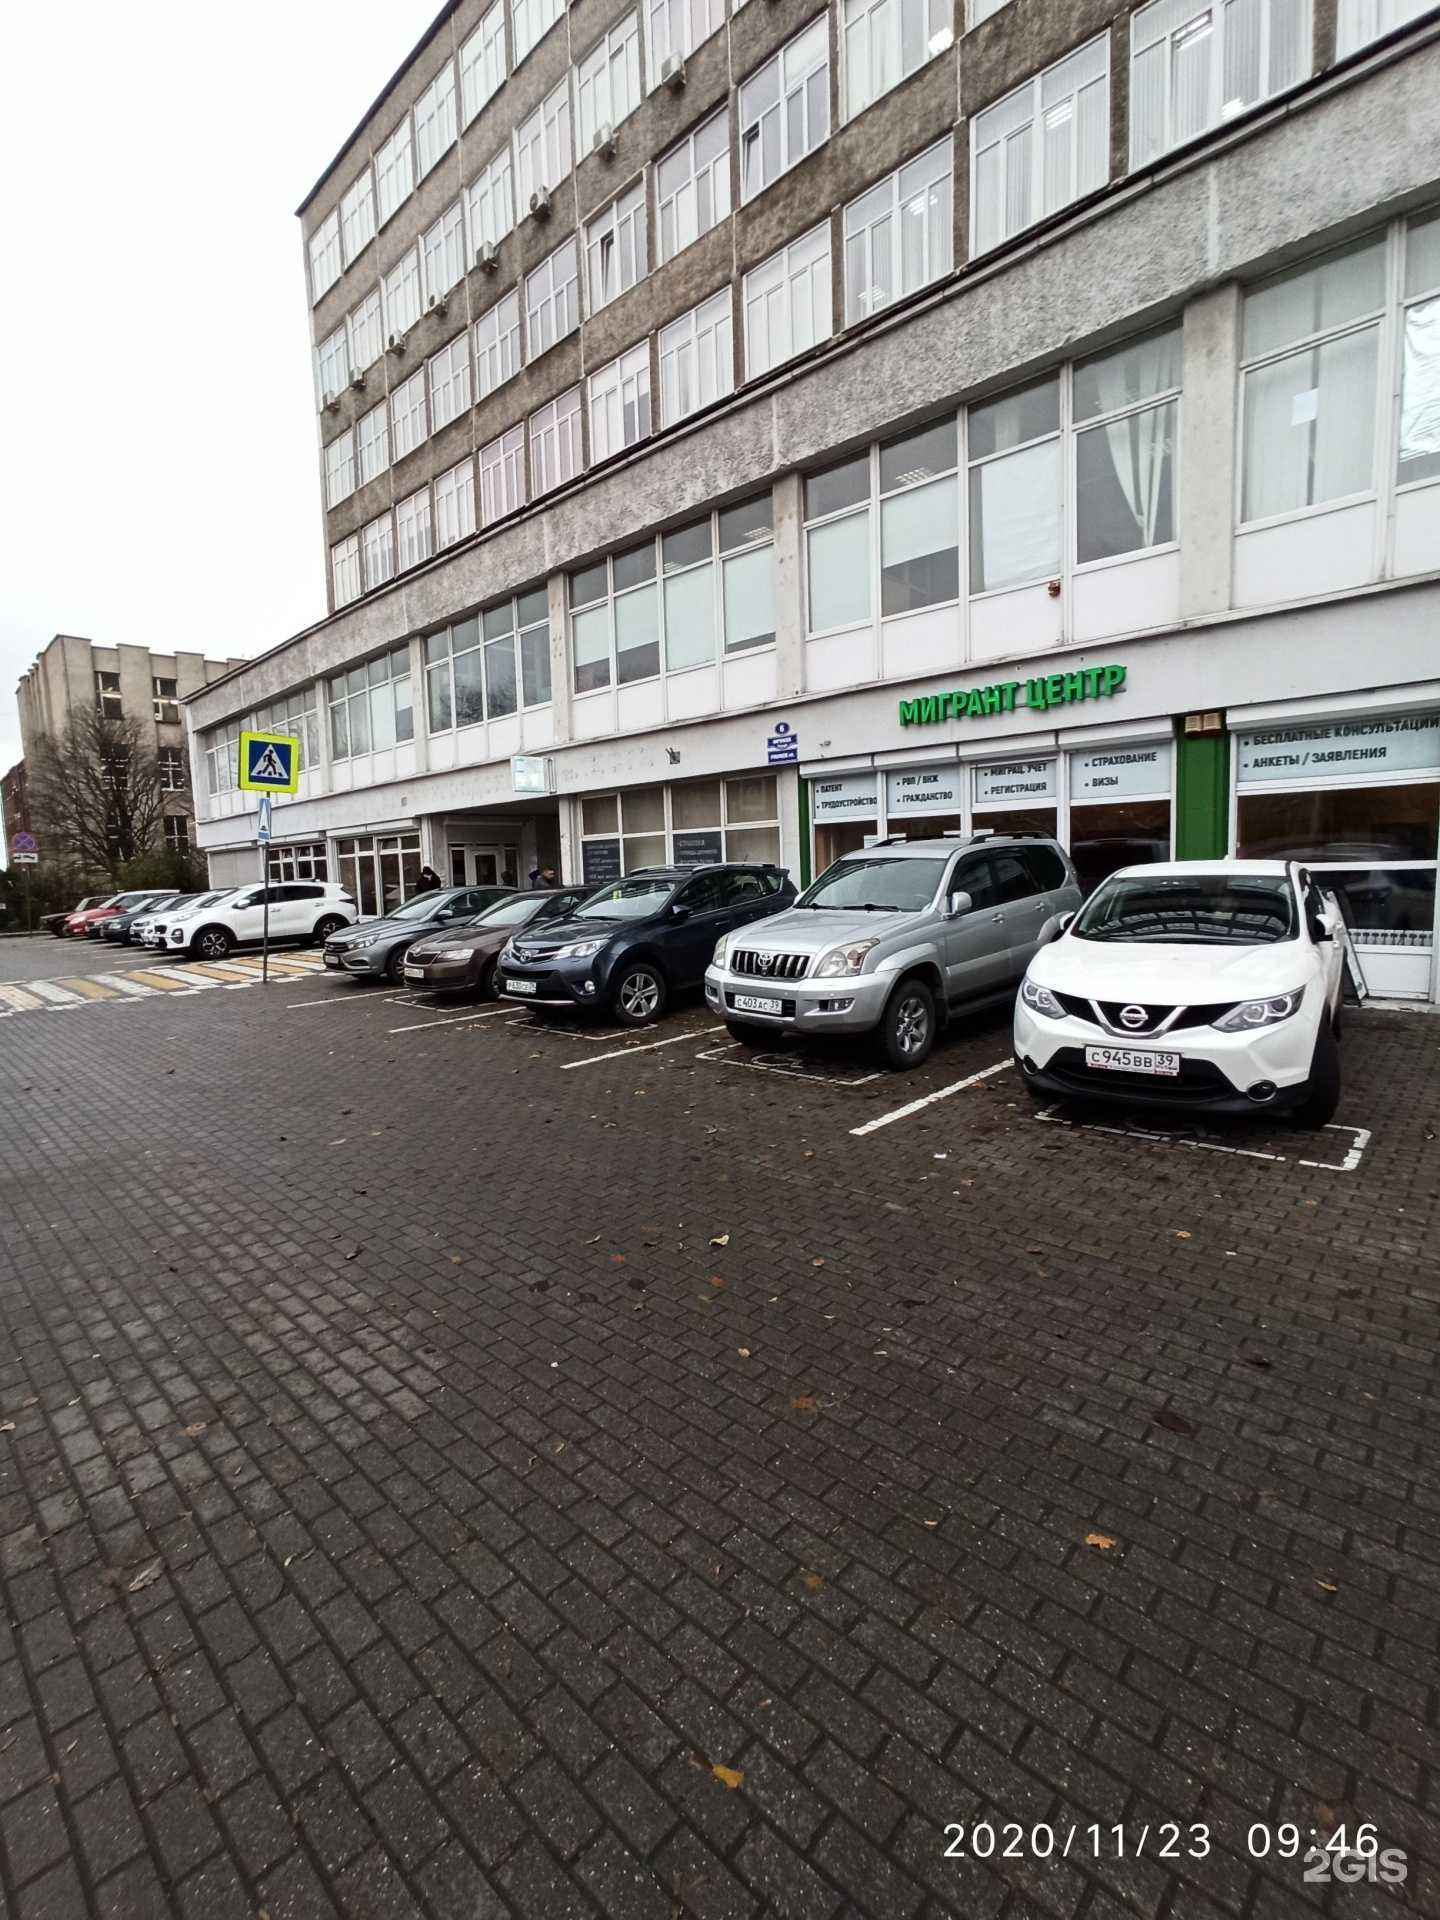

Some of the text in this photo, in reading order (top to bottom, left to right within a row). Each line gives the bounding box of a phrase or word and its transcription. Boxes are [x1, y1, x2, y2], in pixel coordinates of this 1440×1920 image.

[899, 664, 1127, 727] МИГРАНТ ЦЕНТР
[1253, 728, 1331, 746] БЕСПЛАТНЫЕ
[1091, 752, 1157, 767] СТРАХОВАНИЕ
[1252, 754, 1300, 768] АНКЕТЫ
[1311, 747, 1387, 763] ЗАЯВЛЕНИЯ
[820, 783, 843, 793] ПАТЕНТ
[990, 782, 1047, 794] РЕГИСТРАЦИЯ
[1091, 776, 1118, 787] ВИЗЫ
[821, 796, 878, 809] ТРУДОУСТРОЙСТВО
[902, 791, 953, 802] ГРАЖДАНСТВО
